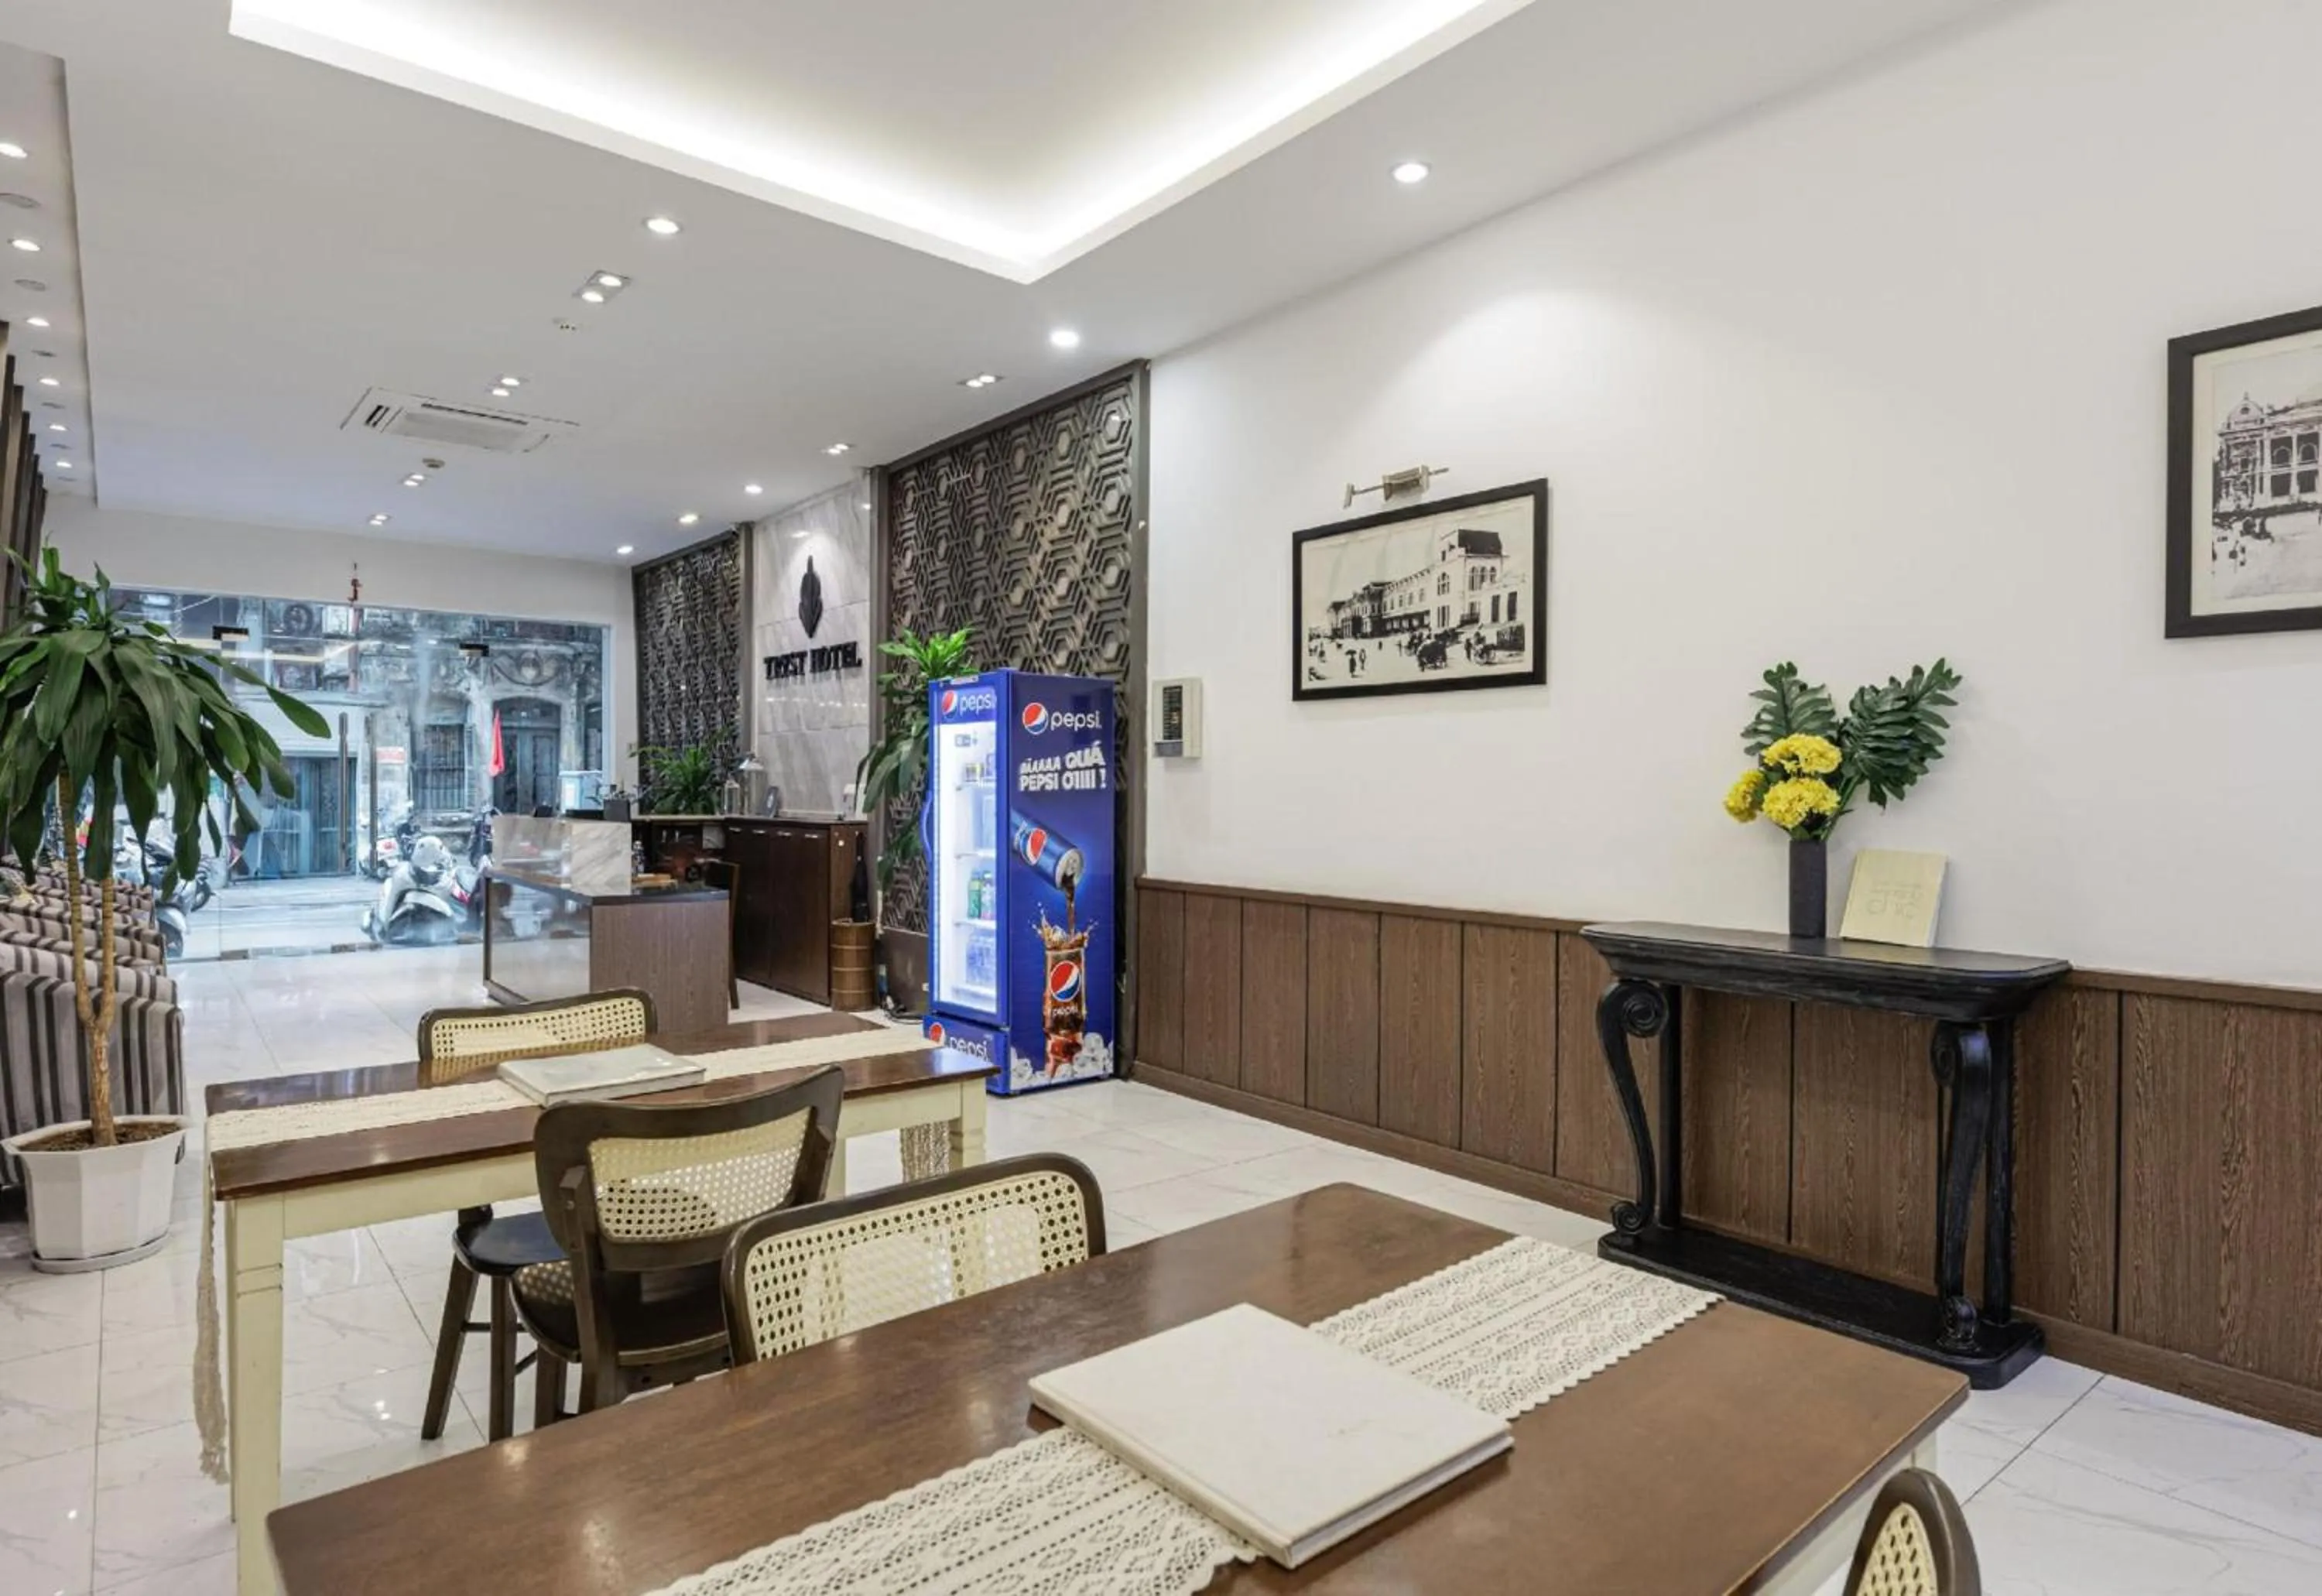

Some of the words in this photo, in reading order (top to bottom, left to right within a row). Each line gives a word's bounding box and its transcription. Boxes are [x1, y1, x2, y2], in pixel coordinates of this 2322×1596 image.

[810, 642, 862, 673] HOTEL
[1050, 711, 1100, 731] pepsi
[1065, 741, 1105, 769] QUÁ
[1020, 772, 1058, 790] PEPSI
